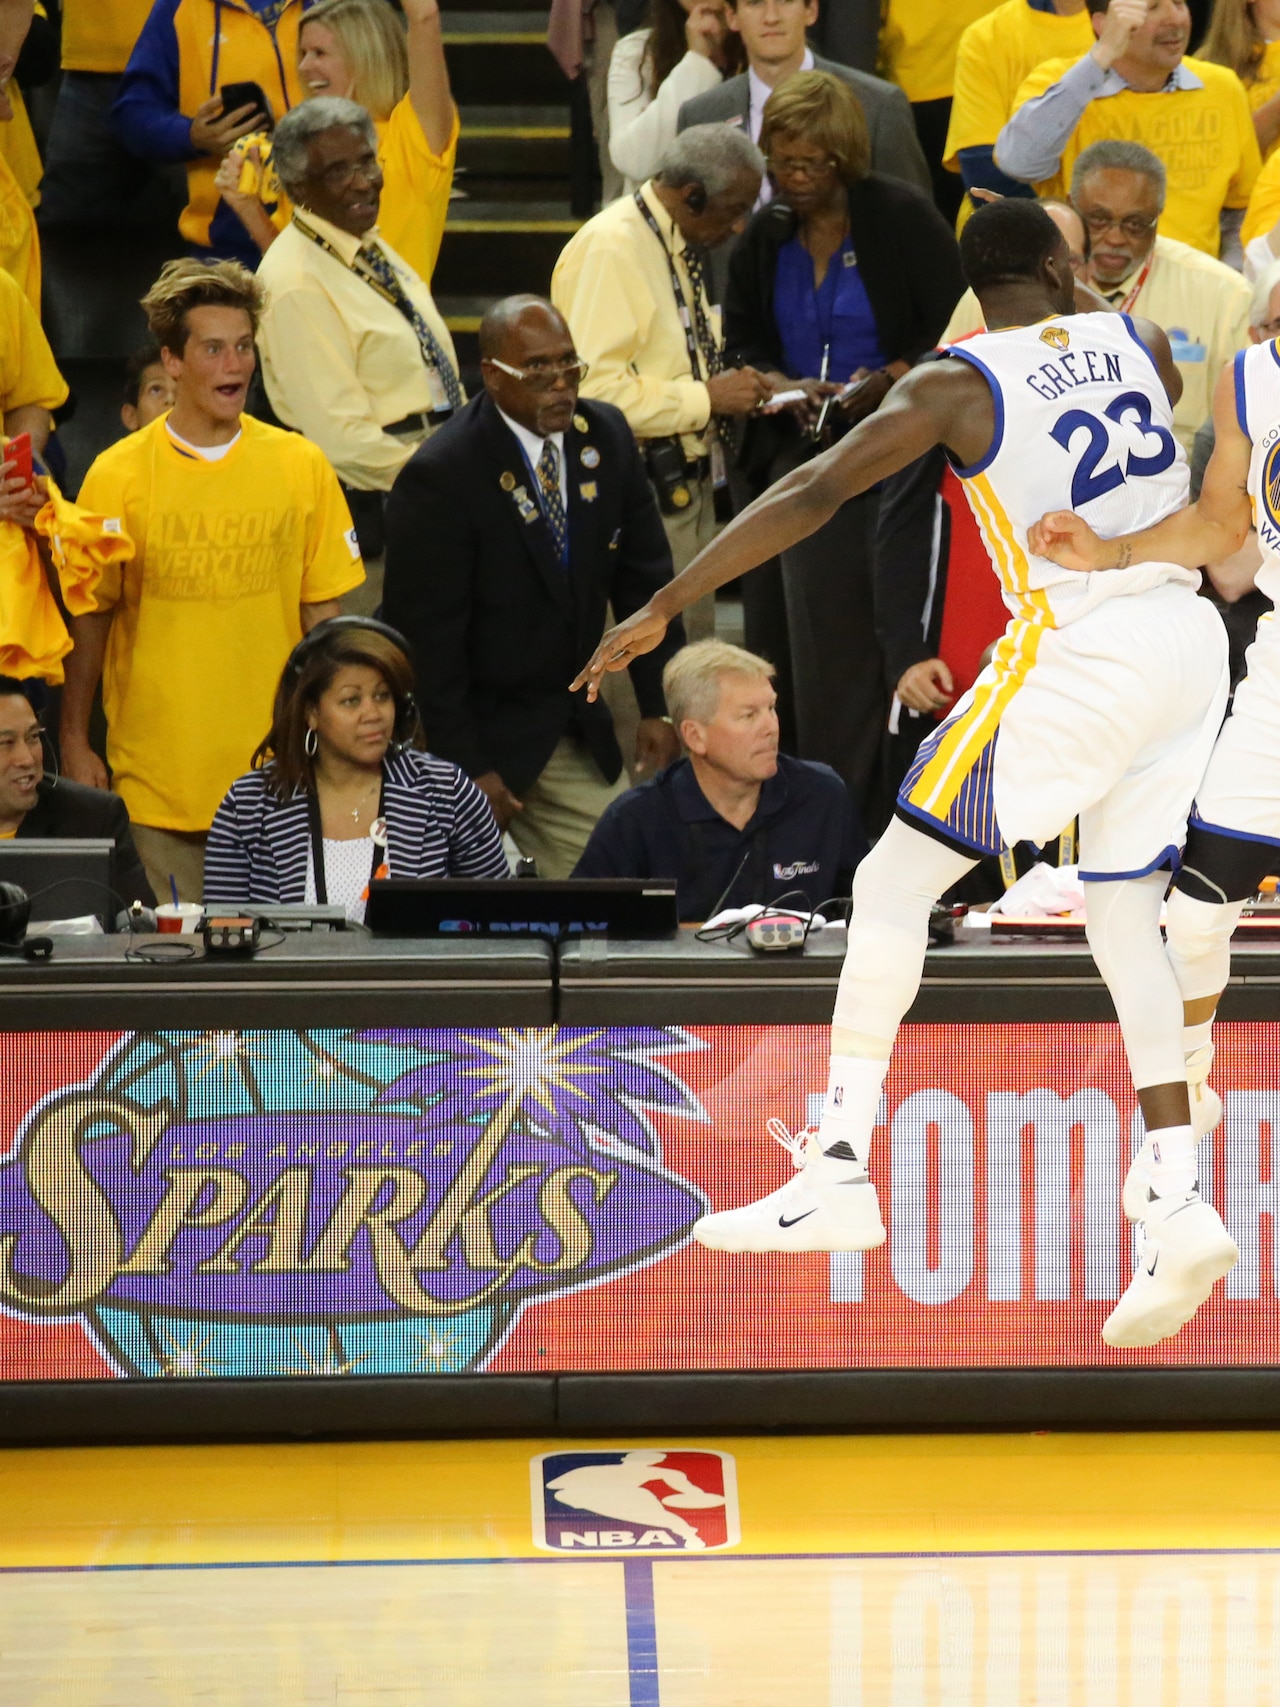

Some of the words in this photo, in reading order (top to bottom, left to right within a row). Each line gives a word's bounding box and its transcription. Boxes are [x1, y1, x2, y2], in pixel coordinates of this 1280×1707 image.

[1026, 351, 1123, 401] GREEN
[1048, 391, 1176, 511] 23
[170, 1141, 240, 1160] LOS
[267, 1140, 454, 1159] ANGELES
[0, 1092, 620, 1317] SPARKS
[559, 1529, 678, 1547] NBA
